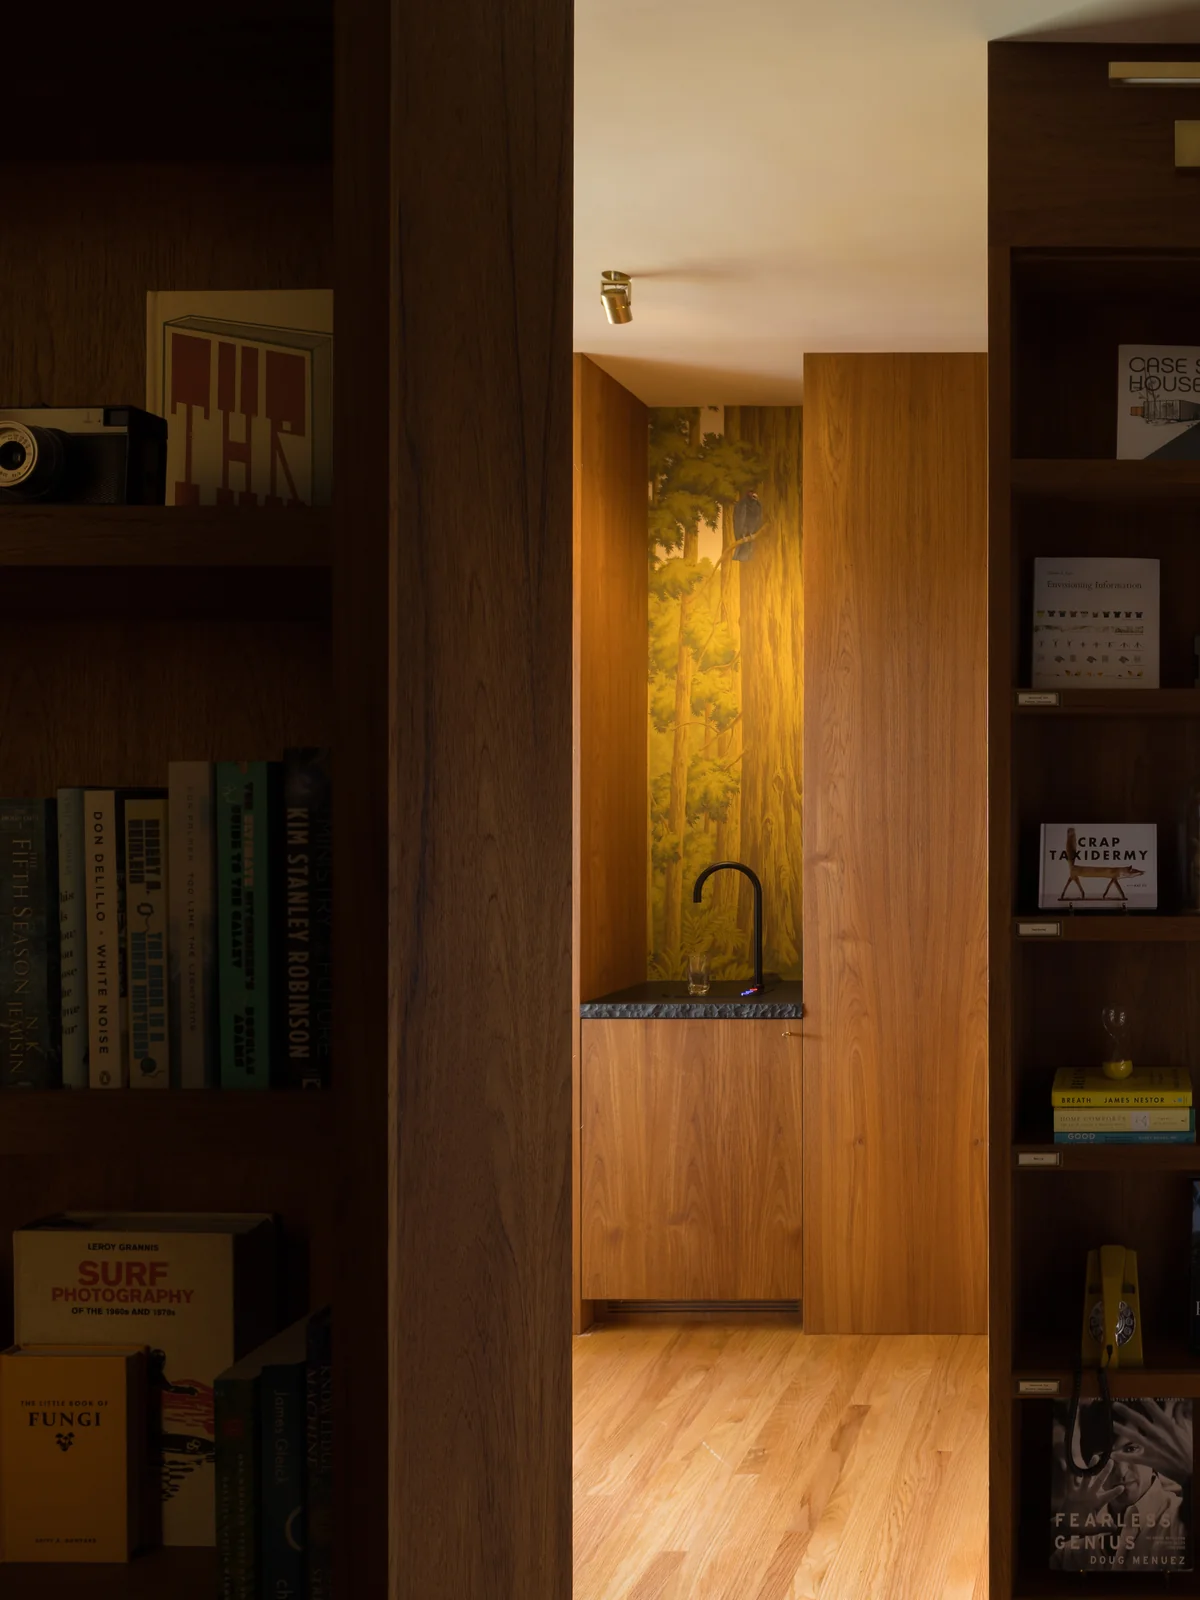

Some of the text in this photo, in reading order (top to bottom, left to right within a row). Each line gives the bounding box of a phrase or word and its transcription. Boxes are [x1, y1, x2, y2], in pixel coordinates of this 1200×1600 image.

[1129, 356, 1187, 374] CASE
[1046, 580, 1143, 591] Envisioning Information
[1077, 836, 1121, 848] CRAP
[1049, 850, 1149, 861] TAXIDERMY
[12, 837, 33, 994] FIFTH SEASON
[93, 811, 110, 1055] DON DELILLO WHITE NOISE
[286, 807, 312, 1060] KIM STANLEY ROBINSON
[87, 1242, 159, 1252] LEROY GRANNIS
[78, 1260, 169, 1287] SURF
[51, 1286, 195, 1304] PHOTOGRAPHY
[71, 1306, 84, 1315] OF
[86, 1306, 103, 1316] THE
[131, 1307, 151, 1317] AND
[28, 1411, 101, 1427] FUNGI
[273, 1389, 290, 1485] James Gleick
[1054, 1512, 1172, 1528] FEARLESS
[1054, 1534, 1136, 1550] GENIUS
[1089, 1554, 1186, 1566] DOUG MENUEZ
